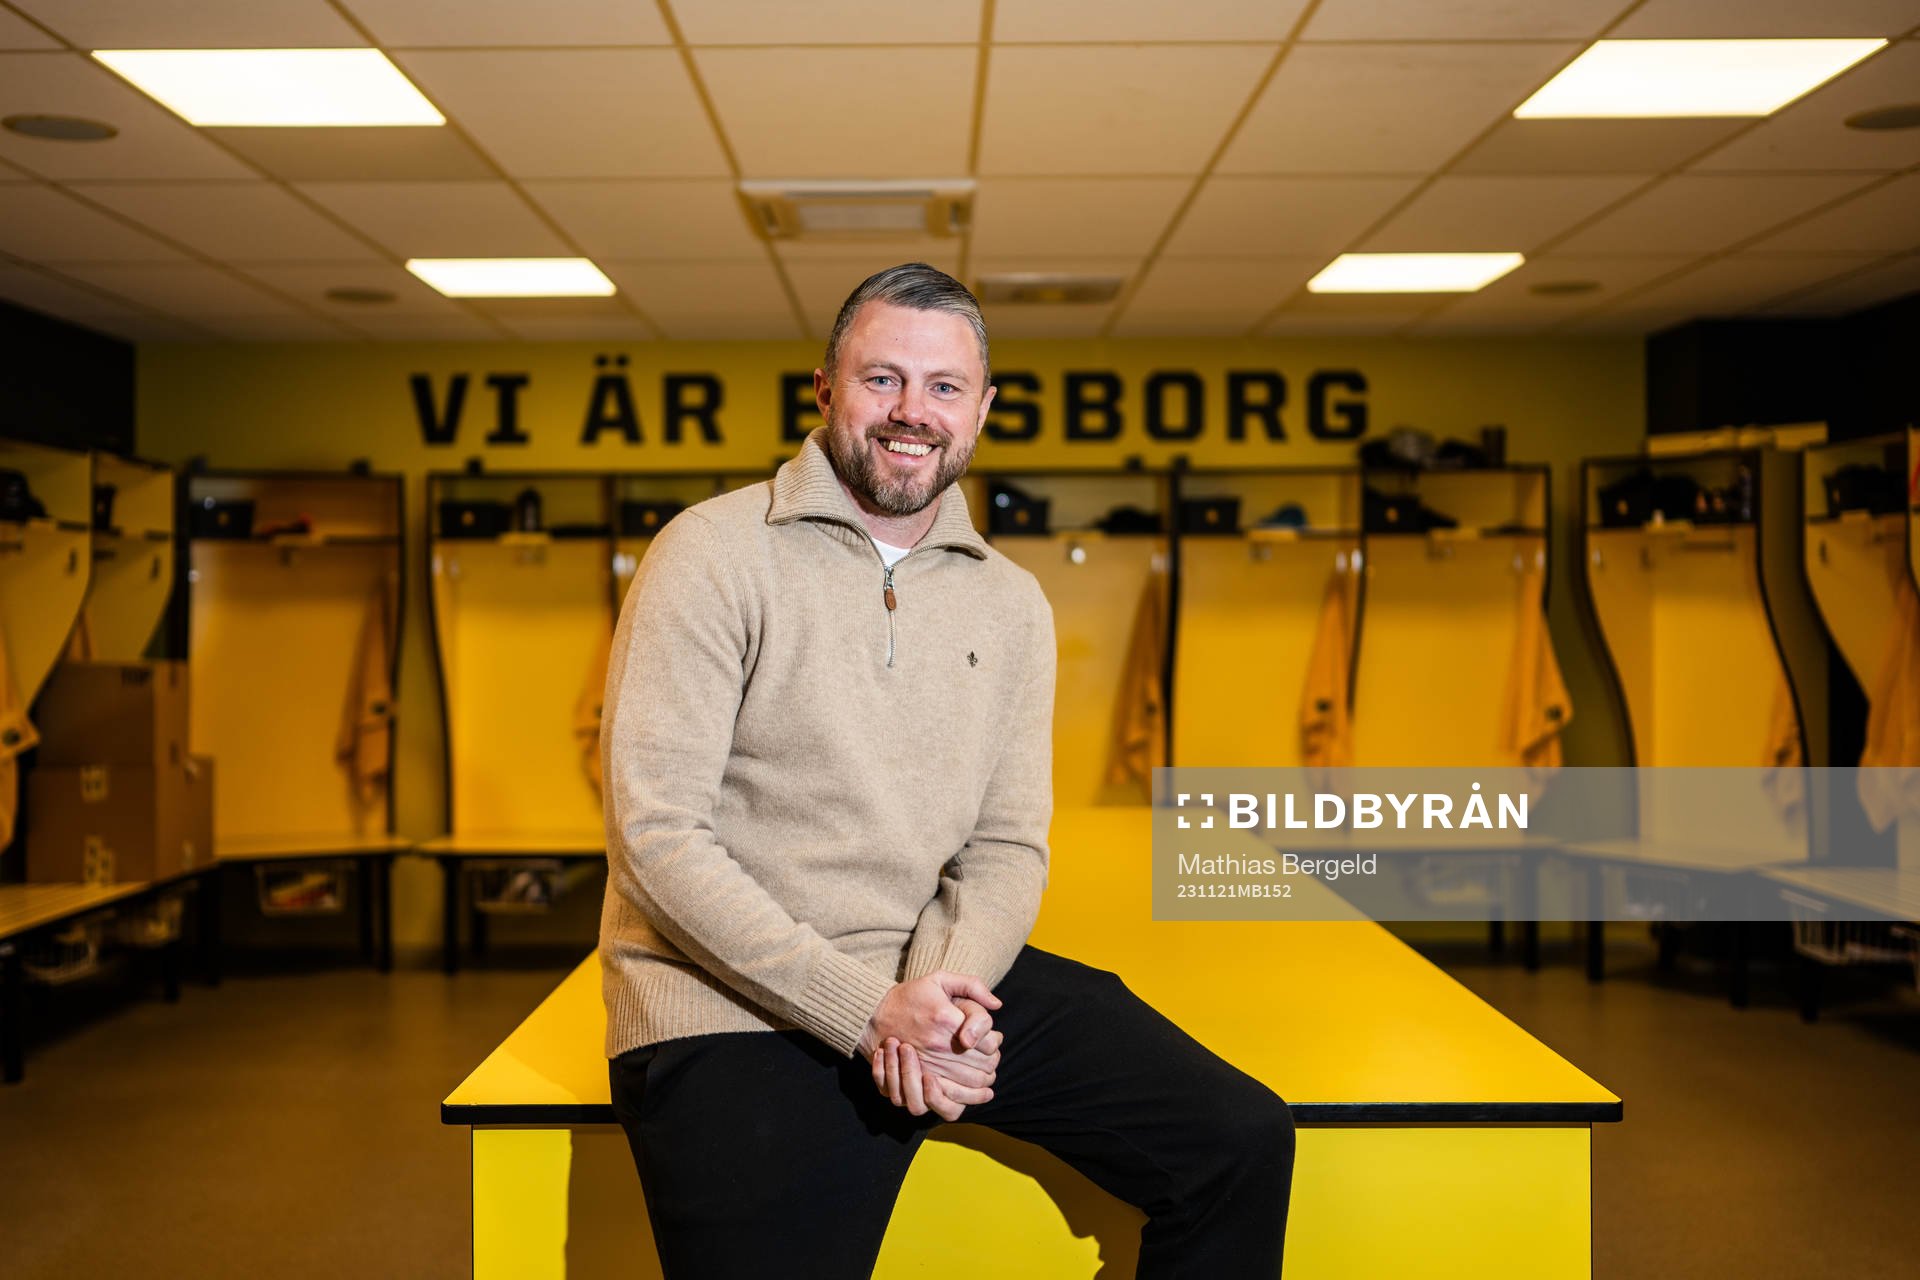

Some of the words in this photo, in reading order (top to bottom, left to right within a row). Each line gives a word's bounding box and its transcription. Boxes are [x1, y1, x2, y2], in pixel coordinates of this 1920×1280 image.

[409, 373, 530, 445] VI
[580, 355, 725, 444] ÄR
[780, 370, 1370, 443] ESBORG
